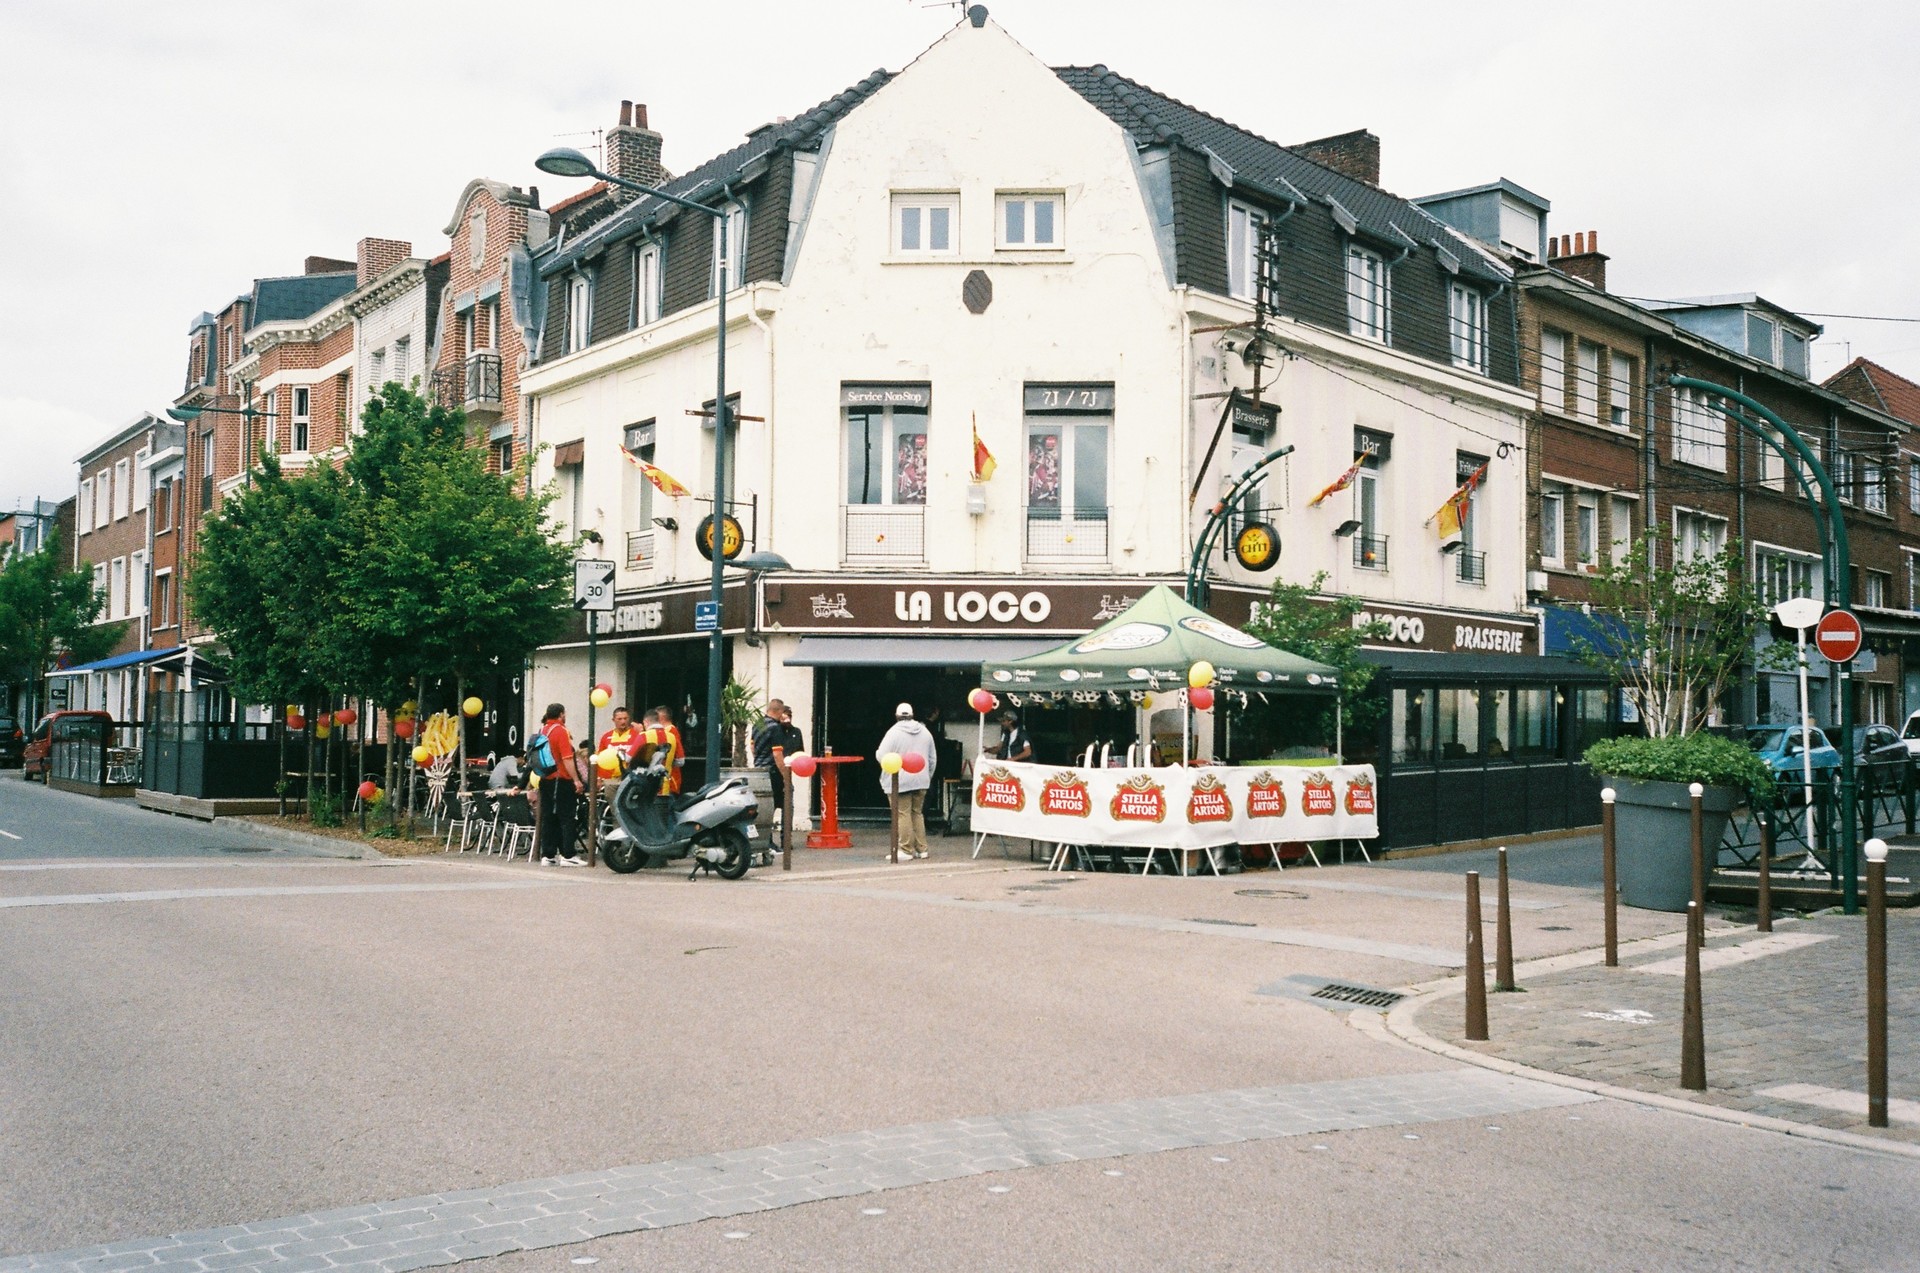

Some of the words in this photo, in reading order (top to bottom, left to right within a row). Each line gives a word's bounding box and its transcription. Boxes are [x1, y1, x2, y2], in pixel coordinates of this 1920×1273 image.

[848, 391, 882, 402] Service
[1043, 391, 1059, 406] 7J
[1065, 390, 1075, 406] /
[1080, 391, 1098, 407] 7J
[1235, 407, 1270, 427] Brasserie
[634, 430, 651, 447] Bar
[1361, 434, 1380, 455] Bar
[587, 585, 603, 597] 30
[895, 591, 932, 622] LA
[944, 590, 1051, 623] LOCO
[1455, 625, 1523, 653] BRASSERIE
[986, 782, 1017, 795] STELLA
[1050, 788, 1083, 800] STELLA
[1308, 789, 1331, 799] STELLA
[985, 792, 1017, 805] ARTOIS
[1121, 793, 1158, 805] STELLA
[1193, 793, 1223, 805] STELLA
[1253, 790, 1278, 800] STELLA
[1049, 799, 1083, 811] ARTOIS
[1120, 804, 1157, 816] ARTOIS
[1194, 804, 1225, 816] ARTOIS
[1252, 800, 1280, 811] ARTOIS
[1309, 799, 1332, 809] ARTOIS
